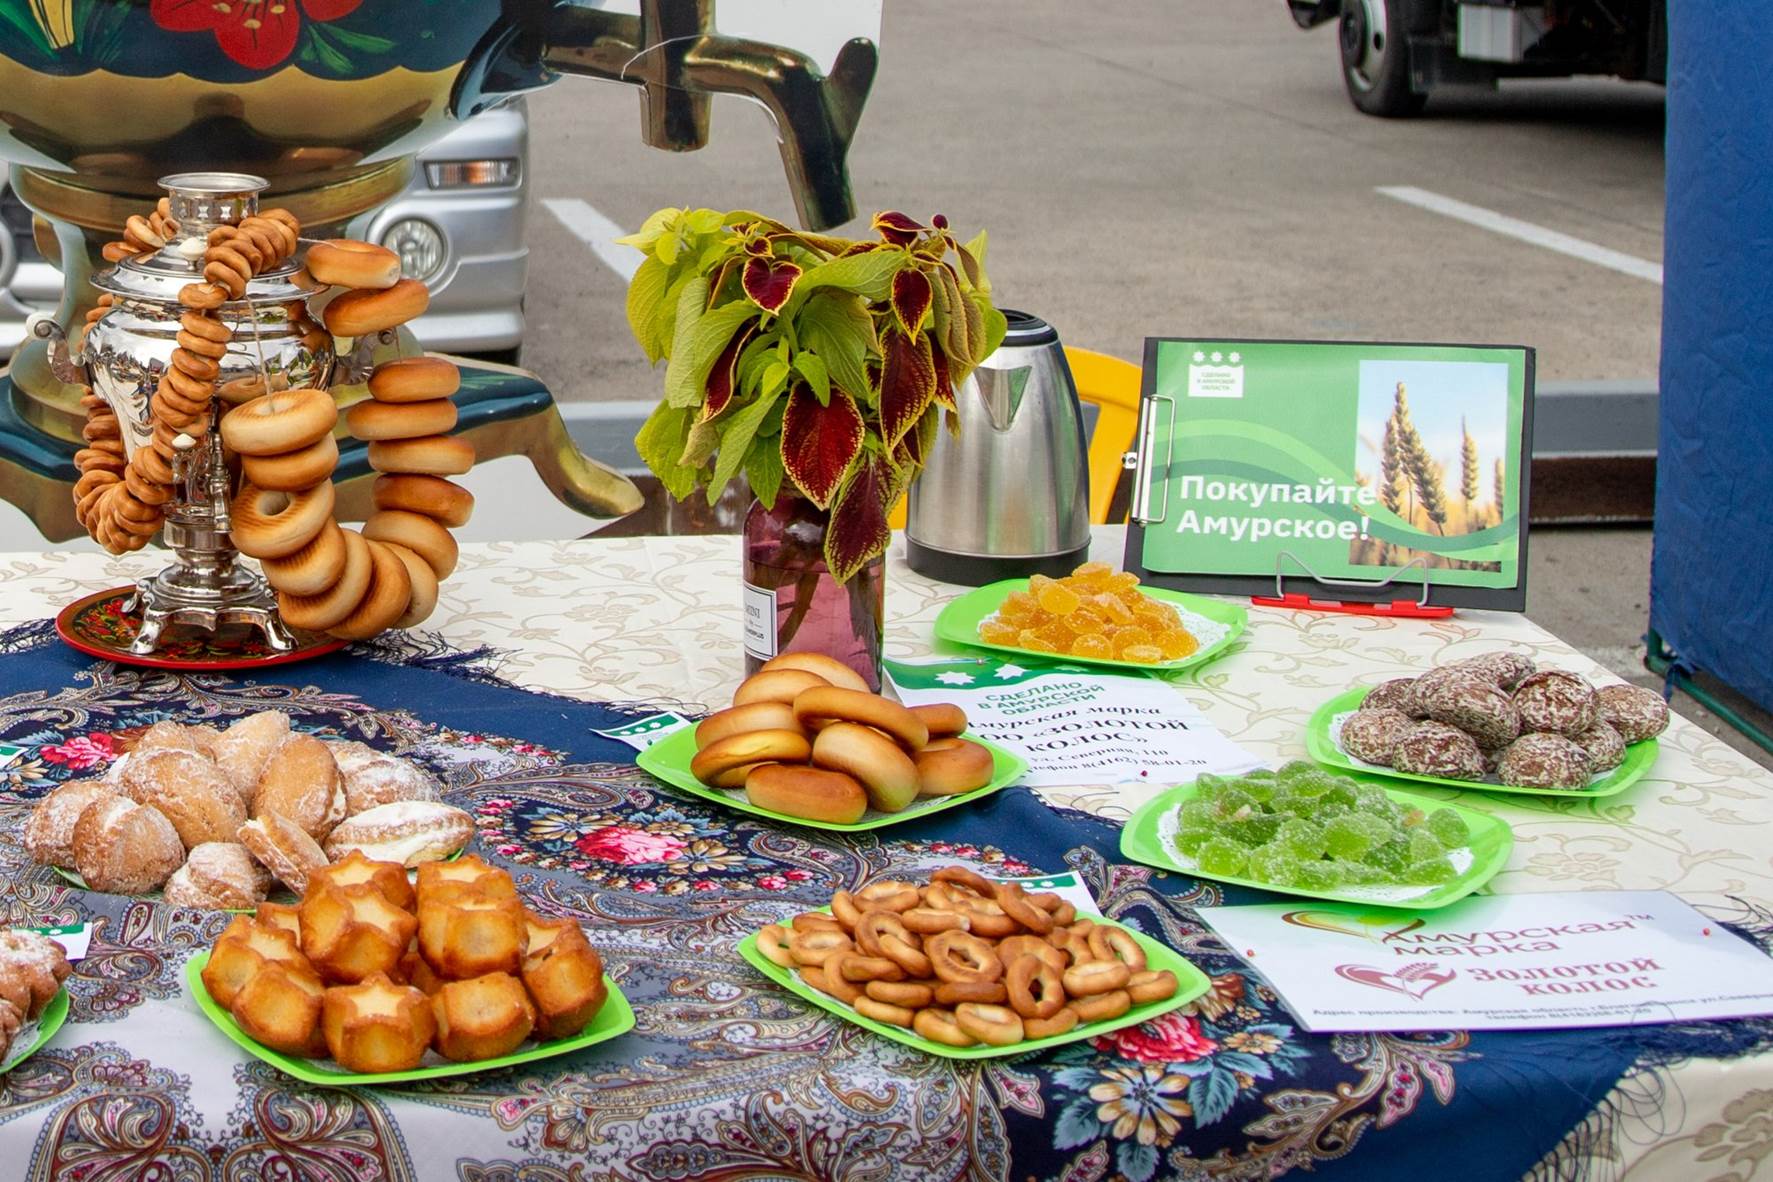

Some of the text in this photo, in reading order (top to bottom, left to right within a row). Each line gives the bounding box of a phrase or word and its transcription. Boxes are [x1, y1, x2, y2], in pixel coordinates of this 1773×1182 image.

[1180, 475, 1377, 508] Покупайте
[1176, 509, 1370, 542] Амурское!
[985, 681, 1082, 701] СДЕЛАНО
[997, 684, 1105, 709] АМУРСКОЙ
[1001, 694, 1096, 715] ОБЛАСТИ
[1086, 706, 1162, 716] марка
[1034, 719, 1190, 738] «ЗОЛОТОЙ
[1393, 939, 1561, 957] марка
[1466, 958, 1664, 982] ЗОЛОТОЙ
[1519, 976, 1658, 997] КОЛОС
